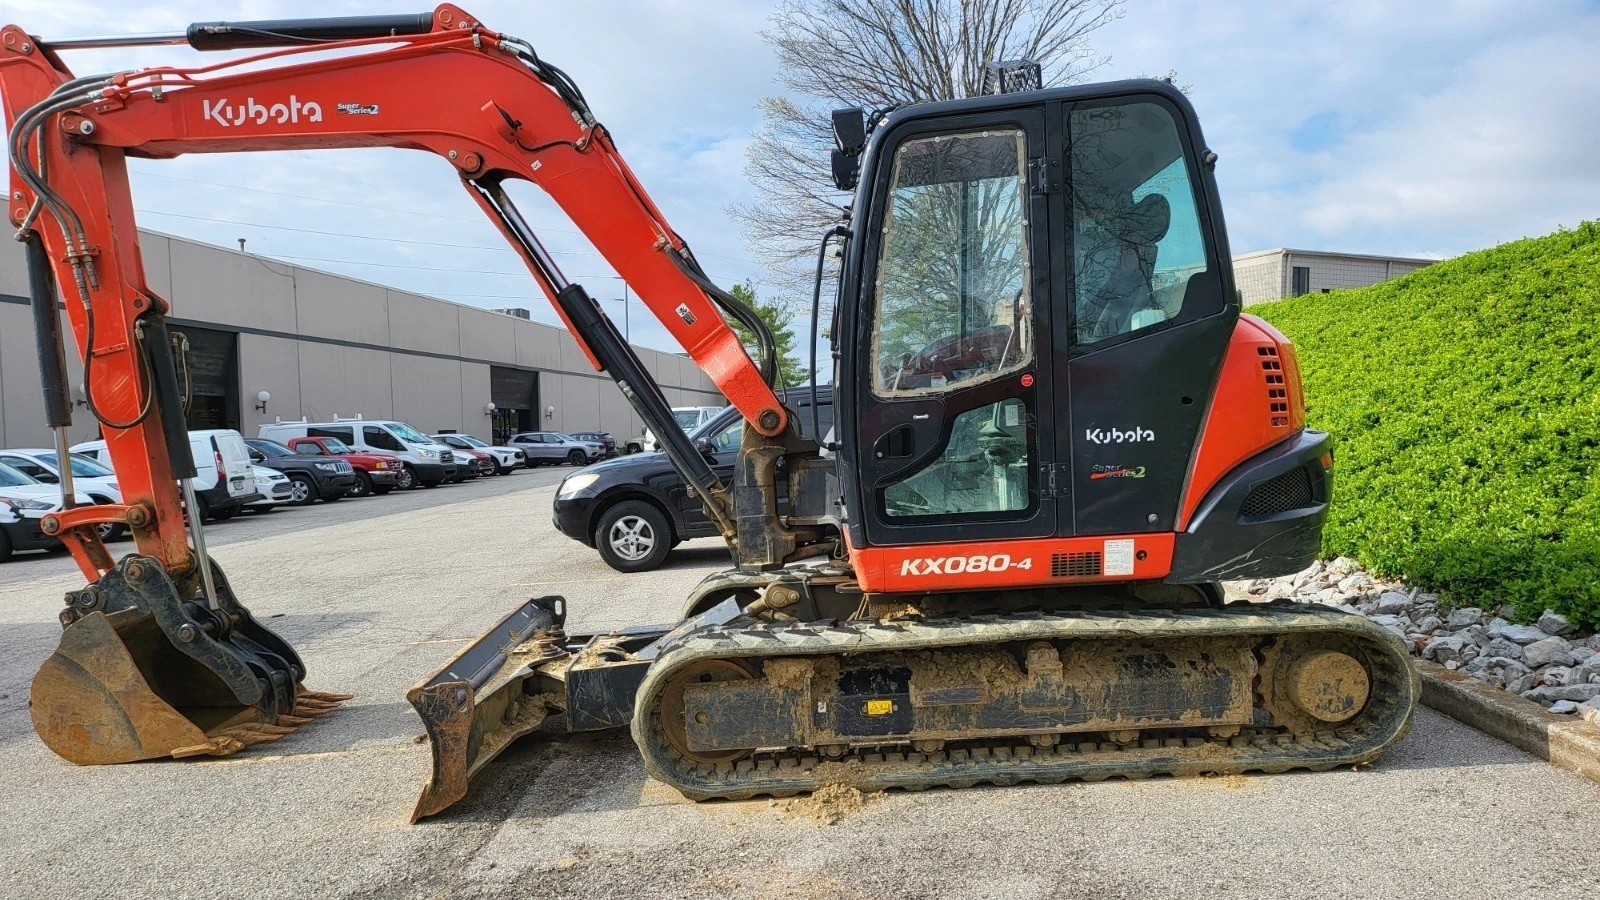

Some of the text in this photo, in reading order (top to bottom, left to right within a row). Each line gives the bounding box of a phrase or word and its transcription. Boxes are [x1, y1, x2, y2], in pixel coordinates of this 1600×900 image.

[203, 95, 323, 127] Kubota
[337, 103, 360, 111] Super
[1086, 426, 1155, 444] Kubota
[901, 554, 1032, 576] KX080-4
